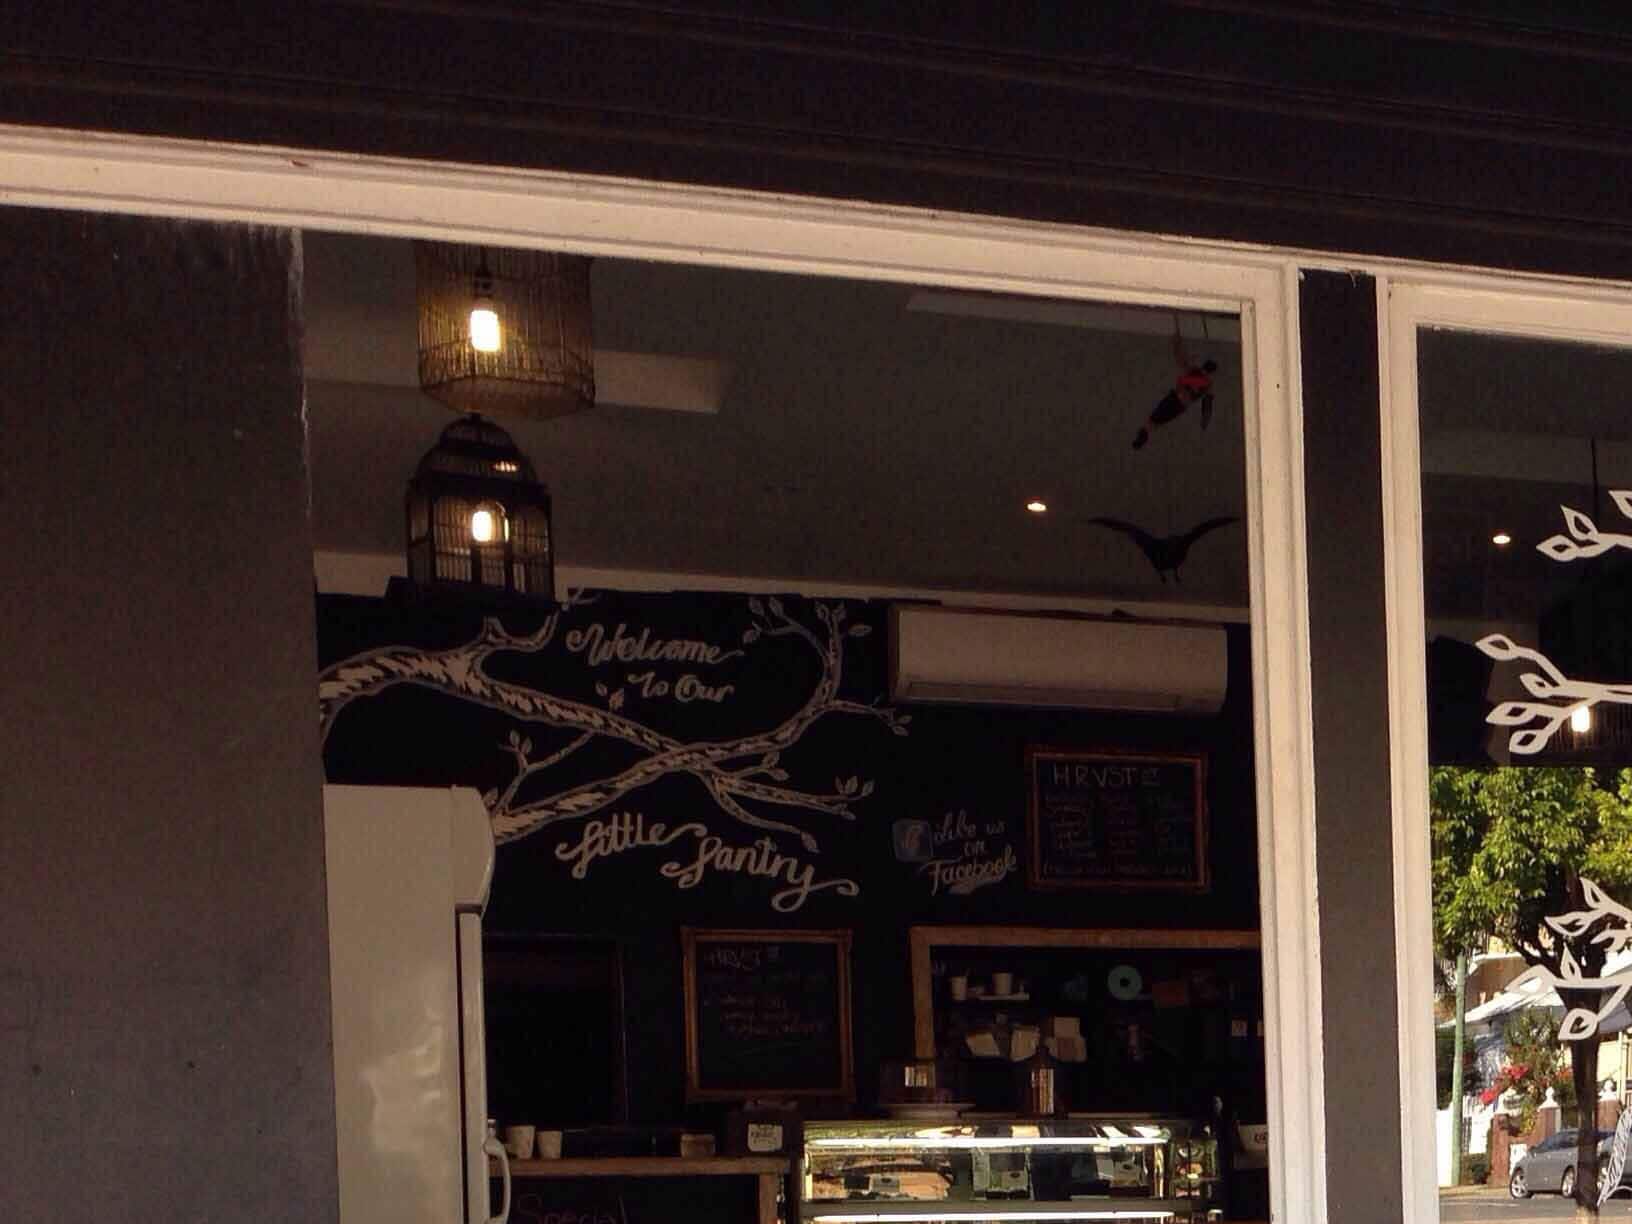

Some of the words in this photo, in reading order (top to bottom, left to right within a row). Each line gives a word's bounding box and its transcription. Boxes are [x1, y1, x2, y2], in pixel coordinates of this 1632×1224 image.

[565, 622, 745, 668] Welcome
[674, 673, 737, 703] Our
[554, 811, 708, 880] Little
[918, 841, 1018, 896] Facebook
[659, 835, 861, 912] Pantry
